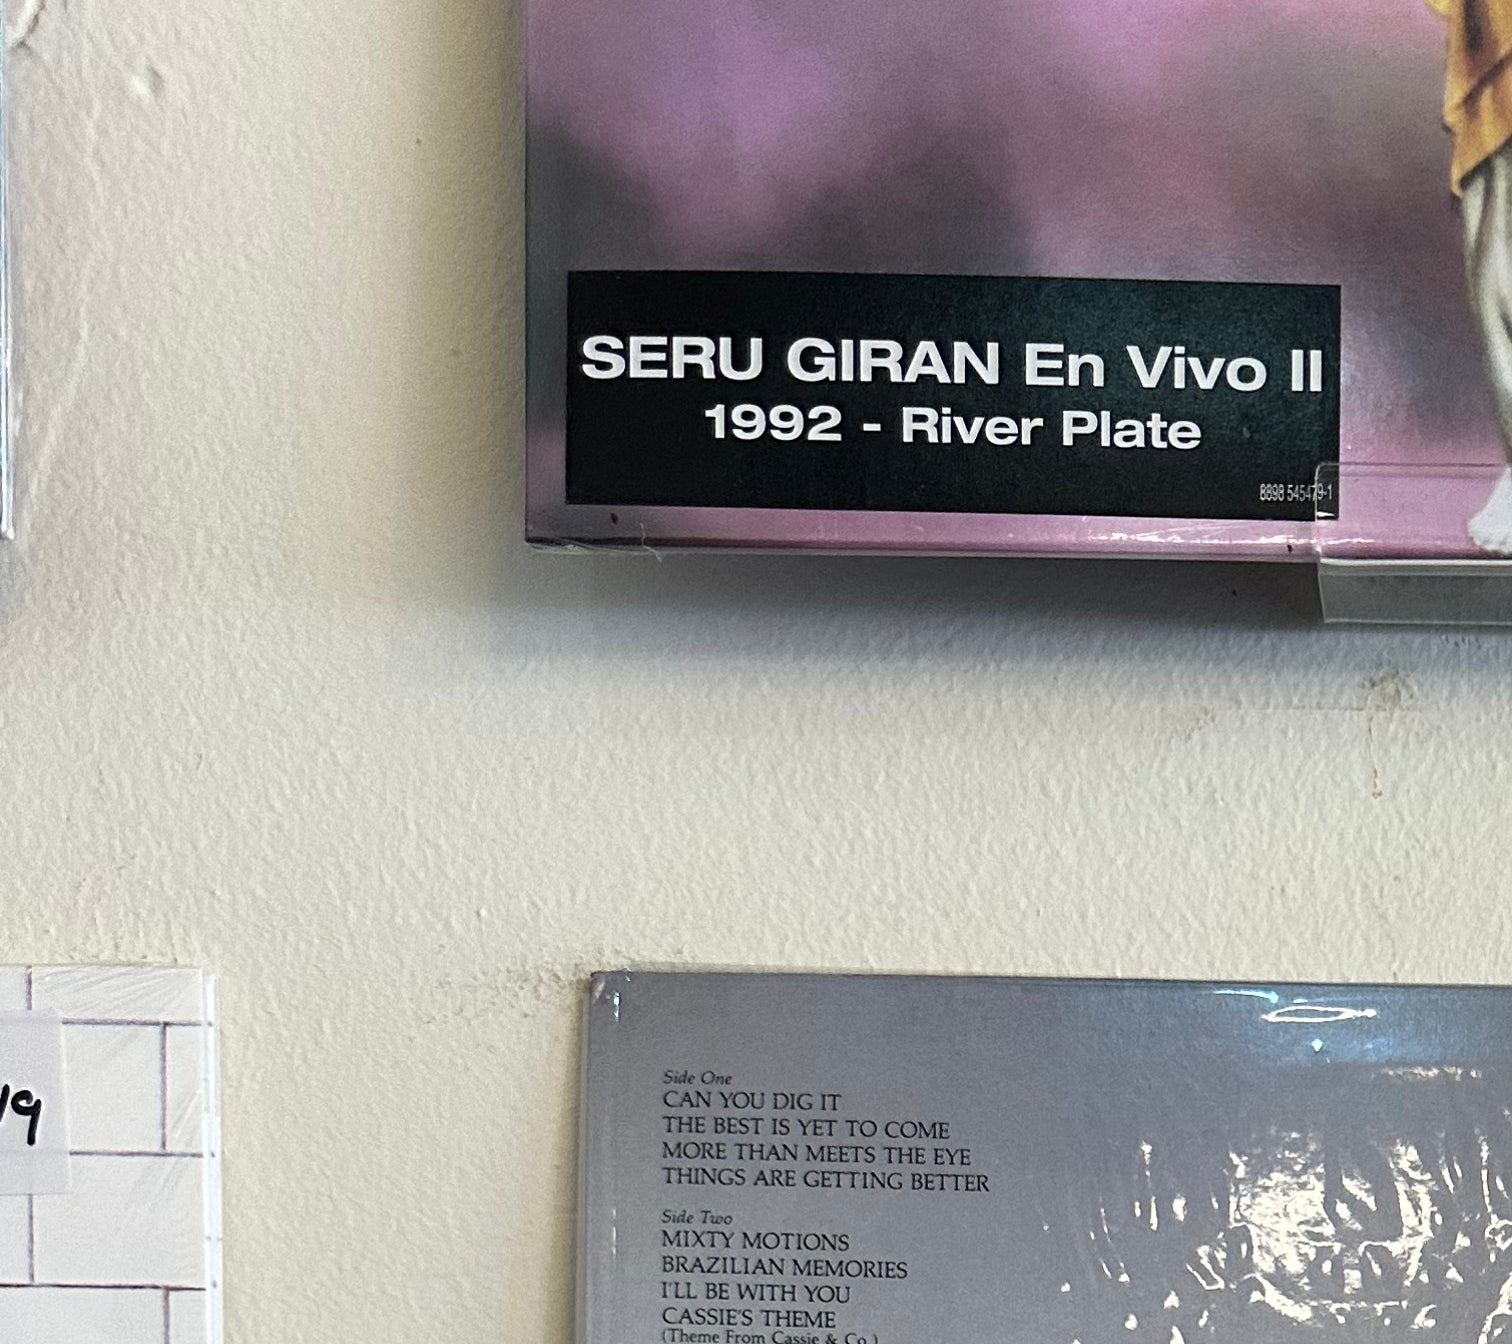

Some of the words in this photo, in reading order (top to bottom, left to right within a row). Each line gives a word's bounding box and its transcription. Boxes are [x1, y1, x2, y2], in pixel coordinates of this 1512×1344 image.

[581, 334, 763, 382] SERU
[787, 336, 1000, 387] GIRAN
[1024, 343, 1105, 388] En
[1126, 344, 1269, 393] Vivo
[1290, 349, 1324, 393] II
[704, 404, 842, 442] 1992
[901, 407, 1044, 447] River
[1062, 410, 1203, 450] Plate
[662, 1069, 696, 1084] Side
[700, 1069, 733, 1085] One
[662, 1089, 712, 1108] CAN
[718, 1090, 765, 1109] YOU
[772, 1092, 812, 1110] DIG
[820, 1093, 842, 1111] IT
[661, 1115, 705, 1133] THE
[713, 1116, 764, 1135] BEST
[771, 1117, 790, 1136] IS
[797, 1118, 838, 1136] YET
[844, 1119, 877, 1137] TO
[883, 1120, 950, 1139] COME
[662, 1141, 727, 1159] MORE
[733, 1142, 798, 1161] THAN
[805, 1144, 875, 1163] MEETS
[882, 1146, 926, 1164] THE
[932, 1147, 971, 1166] EYE
[661, 1166, 746, 1186] THINGS
[752, 1168, 796, 1187] ARE
[802, 1169, 902, 1190] GETTING
[910, 1172, 989, 1192] BETTER
[660, 1208, 694, 1224] Side
[699, 1209, 733, 1225] Two
[661, 1229, 734, 1248] MIXTY
[741, 1231, 849, 1251] MOTIONS
[662, 1255, 784, 1275] BRAZILIAN
[792, 1258, 907, 1279] MEMORIES
[661, 1281, 697, 1299] I'LL
[704, 1281, 729, 1300] BE
[736, 1283, 796, 1302] WITH
[803, 1284, 850, 1303] YOU
[661, 1306, 753, 1326] CASSIE'S
[759, 1309, 836, 1328] THEME
[661, 1327, 720, 1343] (Theme
[724, 1328, 765, 1344] From
